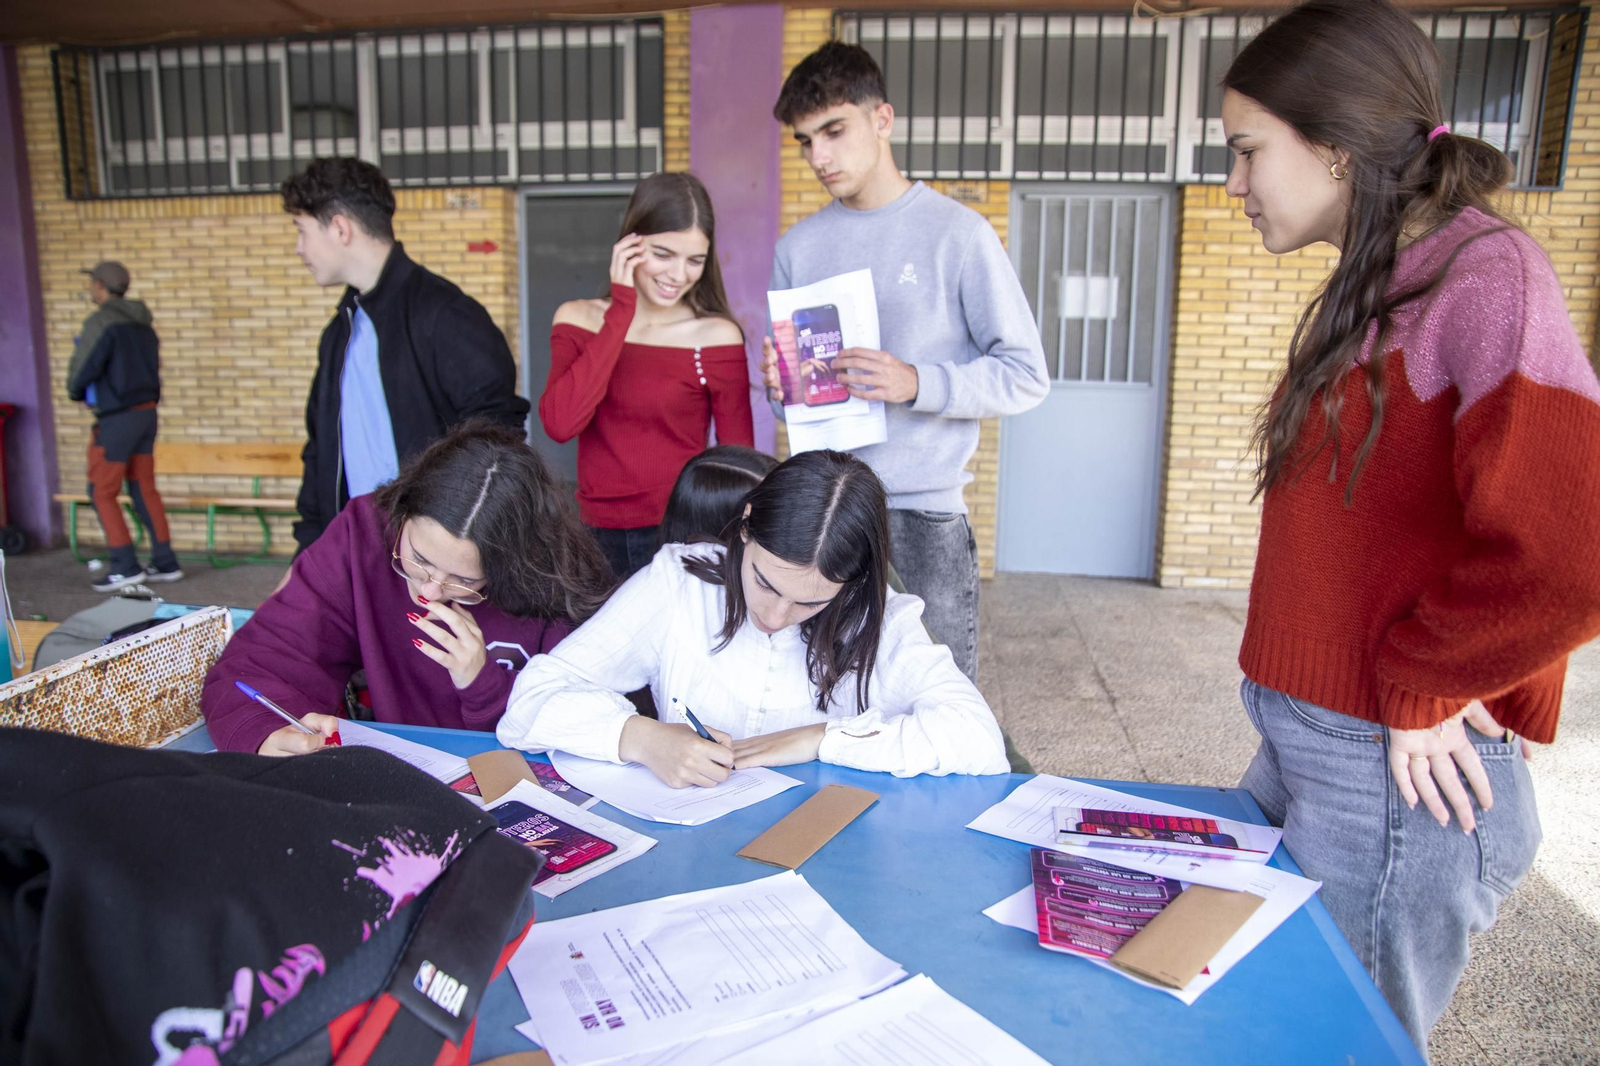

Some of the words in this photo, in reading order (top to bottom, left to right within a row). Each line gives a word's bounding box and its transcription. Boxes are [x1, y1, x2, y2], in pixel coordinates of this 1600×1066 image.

[797, 331, 841, 348] PUTEROS
[813, 344, 826, 354] NO
[519, 829, 537, 839] NO
[426, 969, 469, 1018] NBA
[579, 1013, 600, 1029] SIN
[605, 1016, 625, 1030] NO
